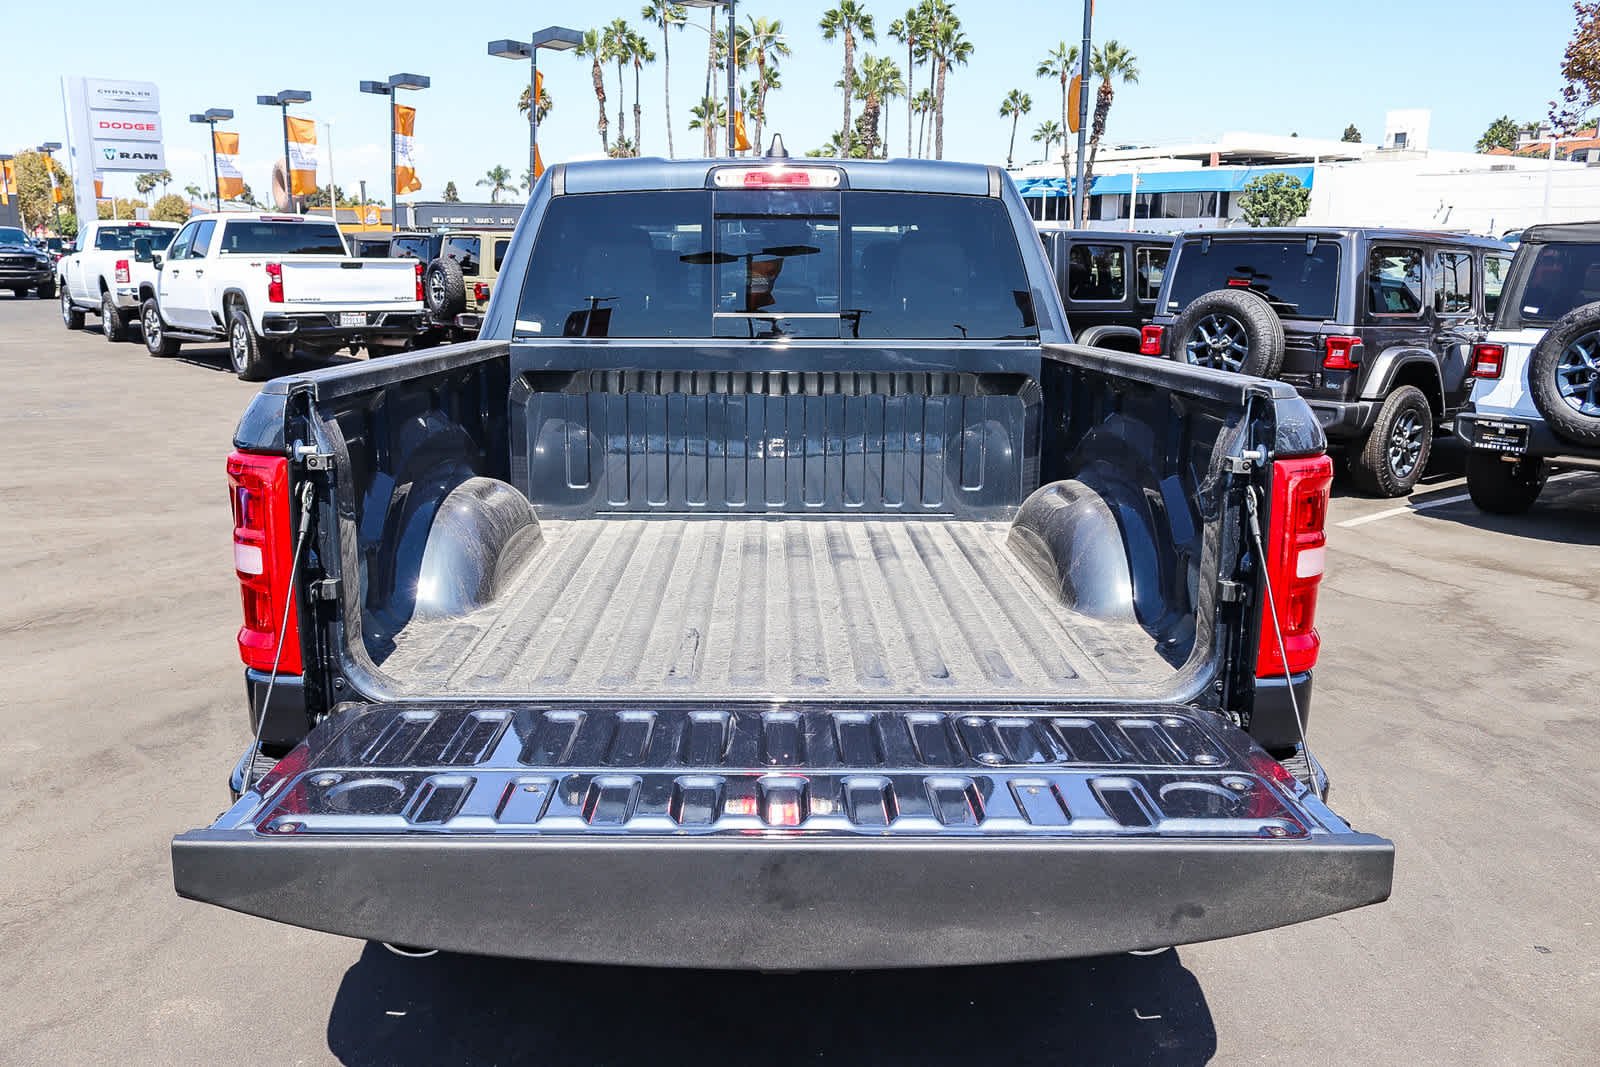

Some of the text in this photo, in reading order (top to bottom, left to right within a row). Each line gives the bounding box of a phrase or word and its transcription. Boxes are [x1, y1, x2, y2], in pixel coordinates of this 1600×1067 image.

[97, 88, 151, 96] CHRYSLER
[99, 121, 157, 131] DODGE
[119, 152, 158, 160] RAM
